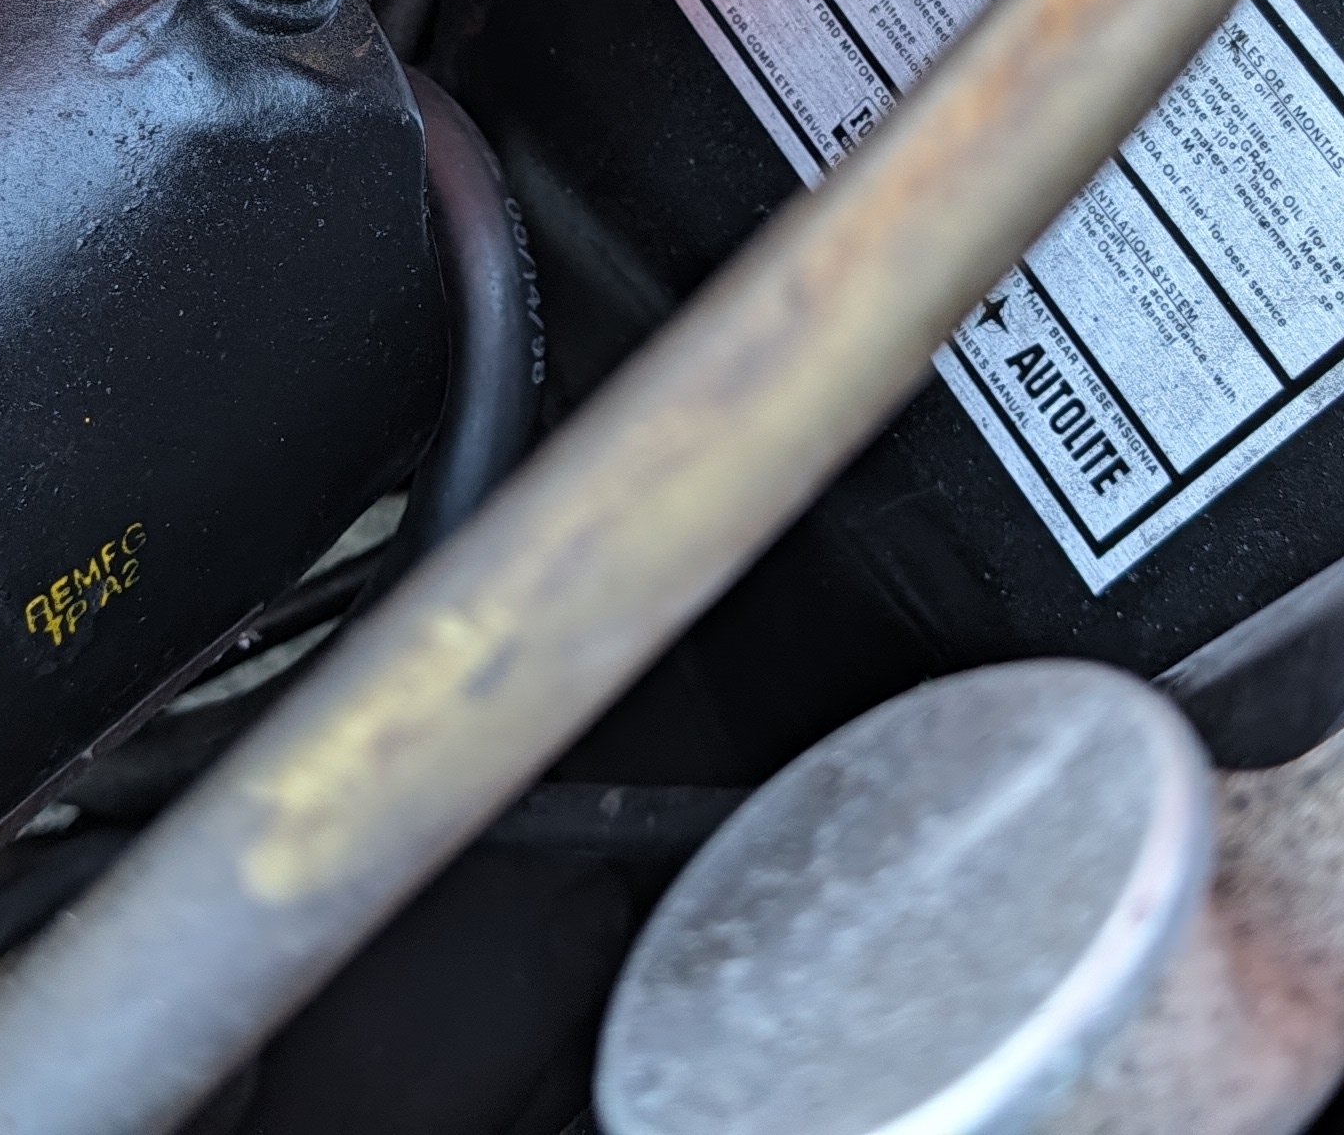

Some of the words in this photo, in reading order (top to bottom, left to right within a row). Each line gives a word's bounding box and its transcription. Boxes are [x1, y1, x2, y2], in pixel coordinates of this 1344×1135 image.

[725, 5, 748, 34] FOR
[746, 33, 794, 99] COMPLETE
[791, 98, 833, 152] SERVICE
[812, 1, 841, 39] FORD
[838, 38, 875, 86] MOTOR
[1191, 53, 1211, 73] oil
[1207, 74, 1233, 102] and
[1229, 102, 1249, 122] oil
[1231, 51, 1255, 80] and
[1253, 81, 1273, 101] oil
[1263, 67, 1285, 93] OR
[1281, 92, 1294, 105] 6
[1166, 95, 1187, 119] car
[1189, 126, 1229, 175] makers
[1233, 182, 1301, 270] requirements
[1173, 83, 1208, 122] above
[1231, 155, 1249, 174] F)
[1247, 174, 1289, 225] labeled
[1240, 138, 1282, 190] GRADE
[1281, 194, 1304, 222] OIL
[1303, 224, 1327, 250] (for
[1078, 214, 1098, 239] the
[1161, 162, 1182, 185] Oil
[1178, 184, 1210, 222] Filter
[1207, 222, 1226, 244] for
[1223, 244, 1250, 278] best
[1075, 186, 1127, 255] eriodically
[1130, 262, 1145, 278] in
[1148, 287, 1207, 364] accordance
[1211, 372, 1237, 404] with
[986, 370, 1029, 429] MANUAL
[1004, 342, 1131, 496] AUTOLITE
[1022, 287, 1051, 323] THAT
[1048, 326, 1079, 365] BEAR
[1078, 365, 1113, 412] THESE
[1110, 412, 1158, 476] INSIGNIA
